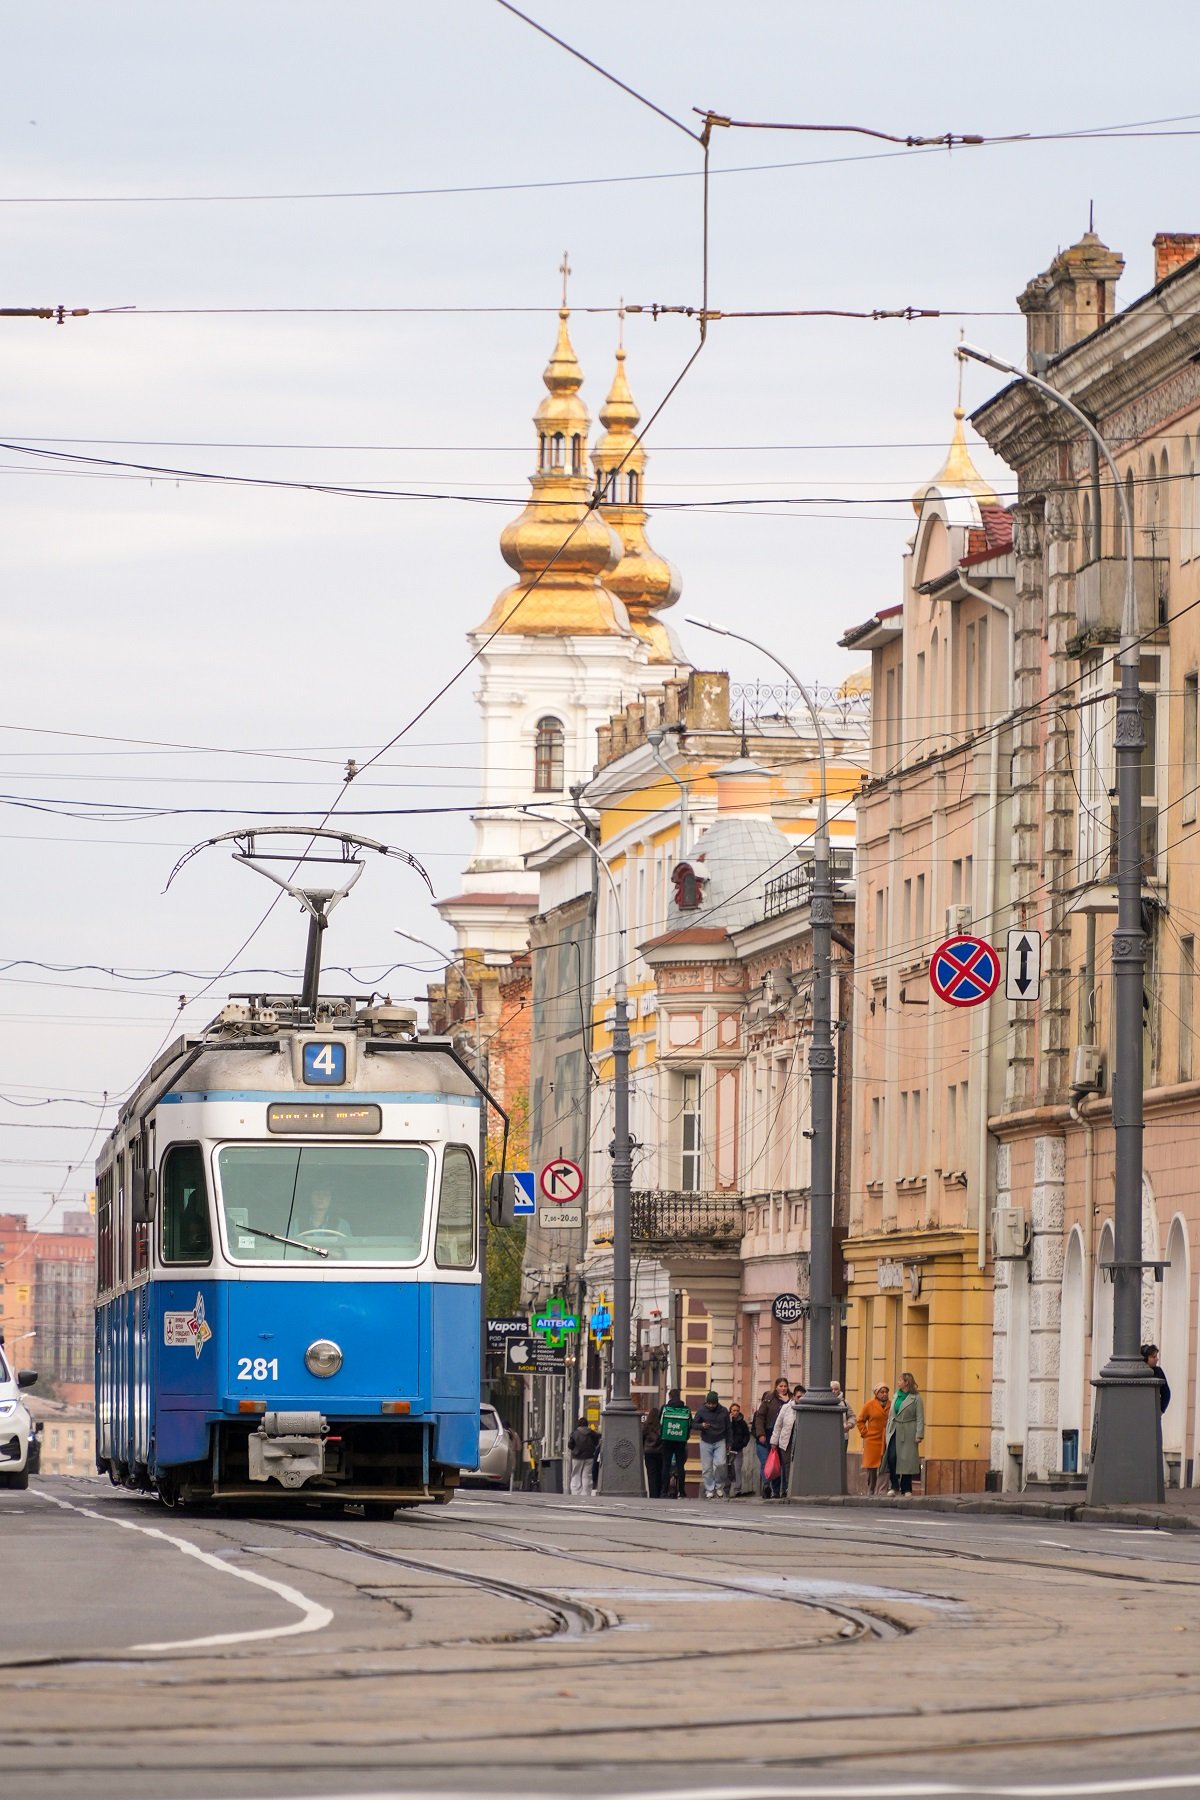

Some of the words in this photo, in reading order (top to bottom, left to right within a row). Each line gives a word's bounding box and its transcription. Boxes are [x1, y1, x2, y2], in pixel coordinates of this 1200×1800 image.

[313, 1043, 336, 1075] 4
[776, 1300, 801, 1309] VAPE
[775, 1309, 802, 1317] SHOP
[487, 1321, 528, 1333] Vapors
[237, 1357, 278, 1381] 281
[666, 1428, 683, 1436] Food
